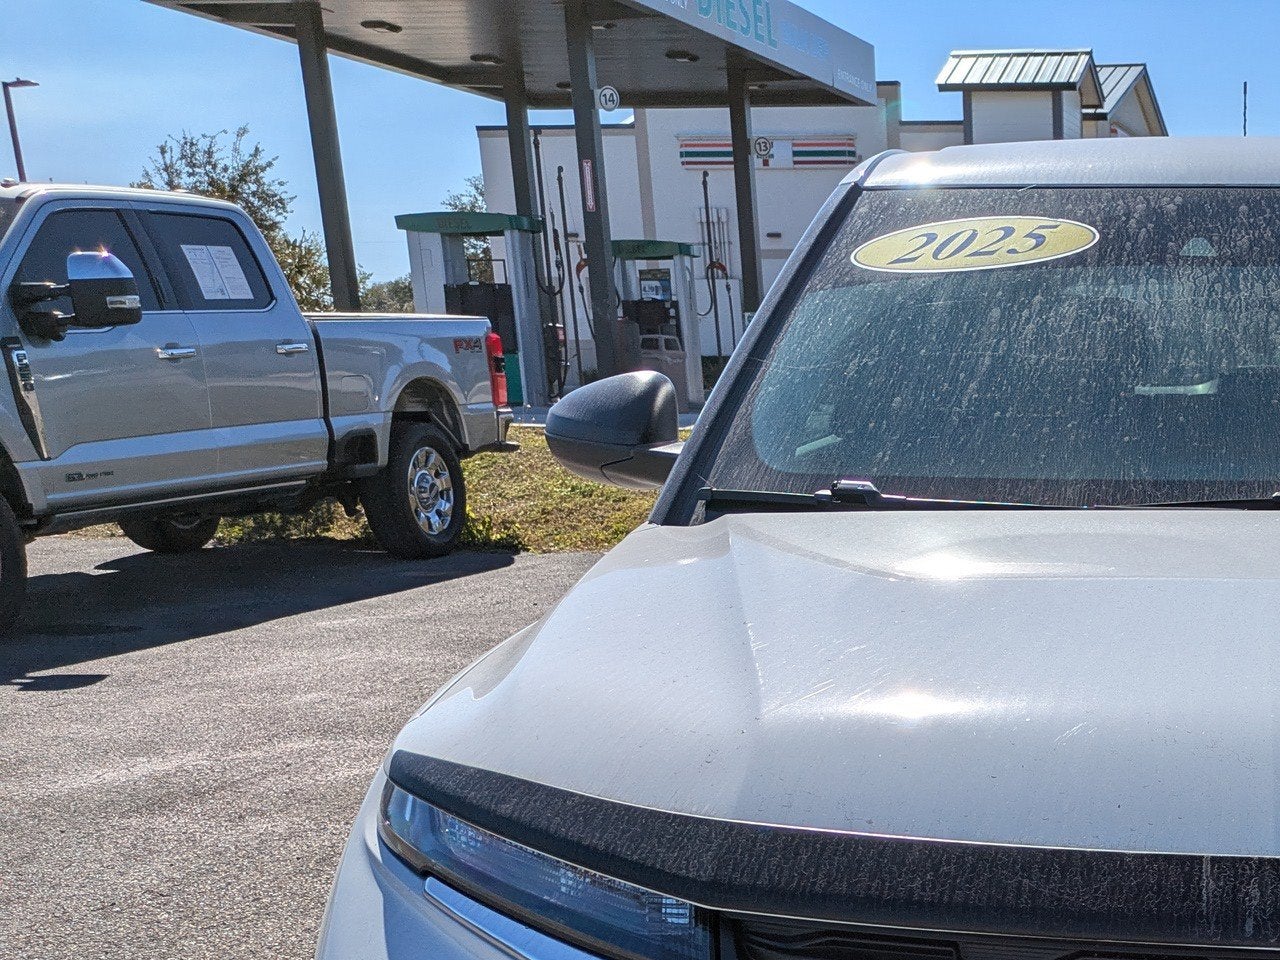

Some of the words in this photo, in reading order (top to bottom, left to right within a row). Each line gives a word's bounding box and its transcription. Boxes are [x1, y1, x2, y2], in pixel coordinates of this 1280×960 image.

[602, 92, 616, 105] 14
[757, 142, 768, 152] 13
[886, 223, 1062, 266] 2025
